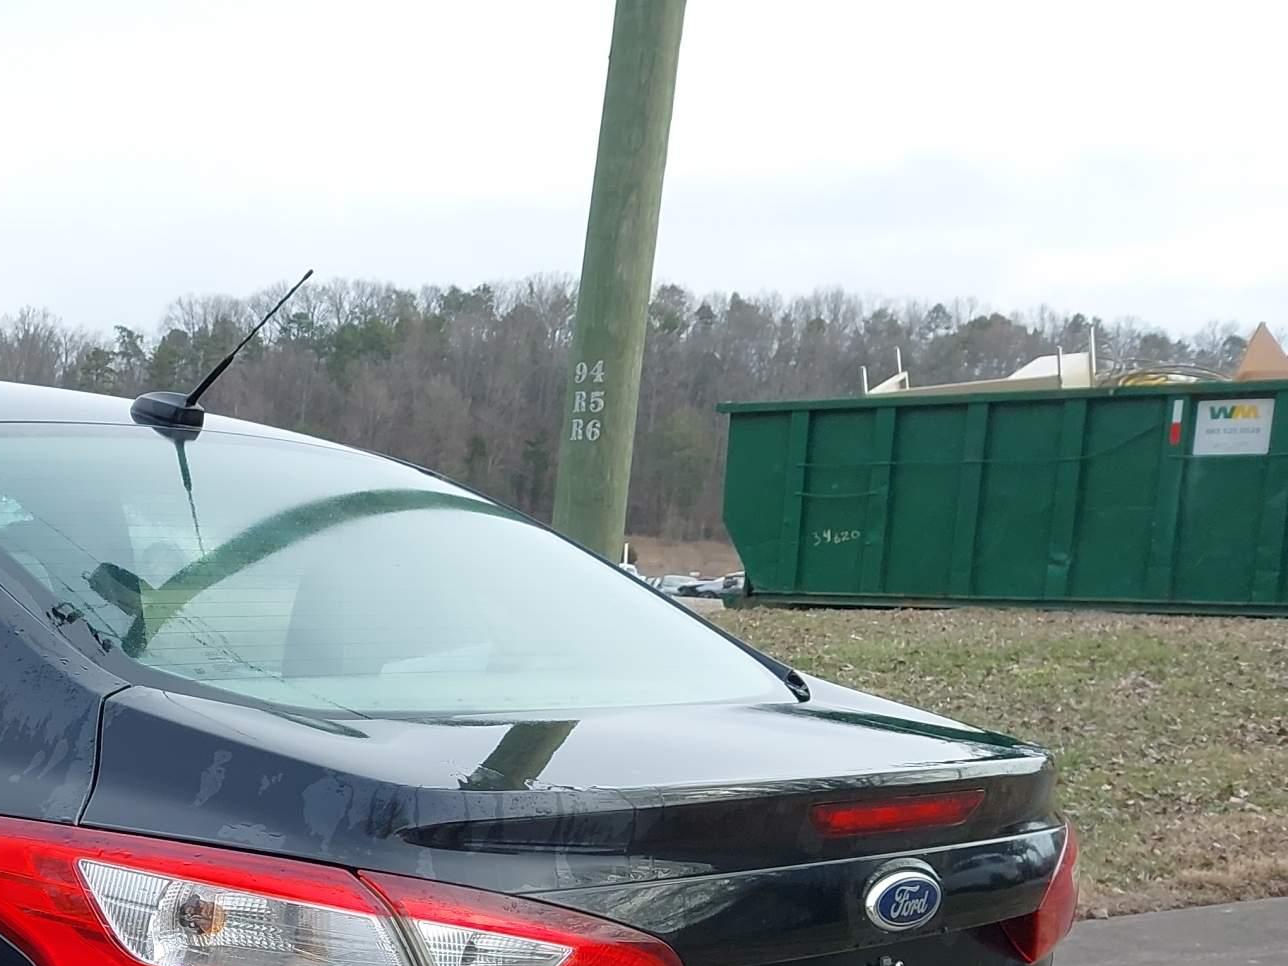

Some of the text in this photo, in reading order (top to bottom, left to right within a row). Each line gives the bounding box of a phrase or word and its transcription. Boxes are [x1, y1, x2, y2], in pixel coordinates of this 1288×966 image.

[574, 360, 605, 384] 94
[572, 390, 605, 413] R5
[1209, 405, 1260, 420] WM
[569, 418, 601, 441] R6
[890, 885, 929, 919] Ford
